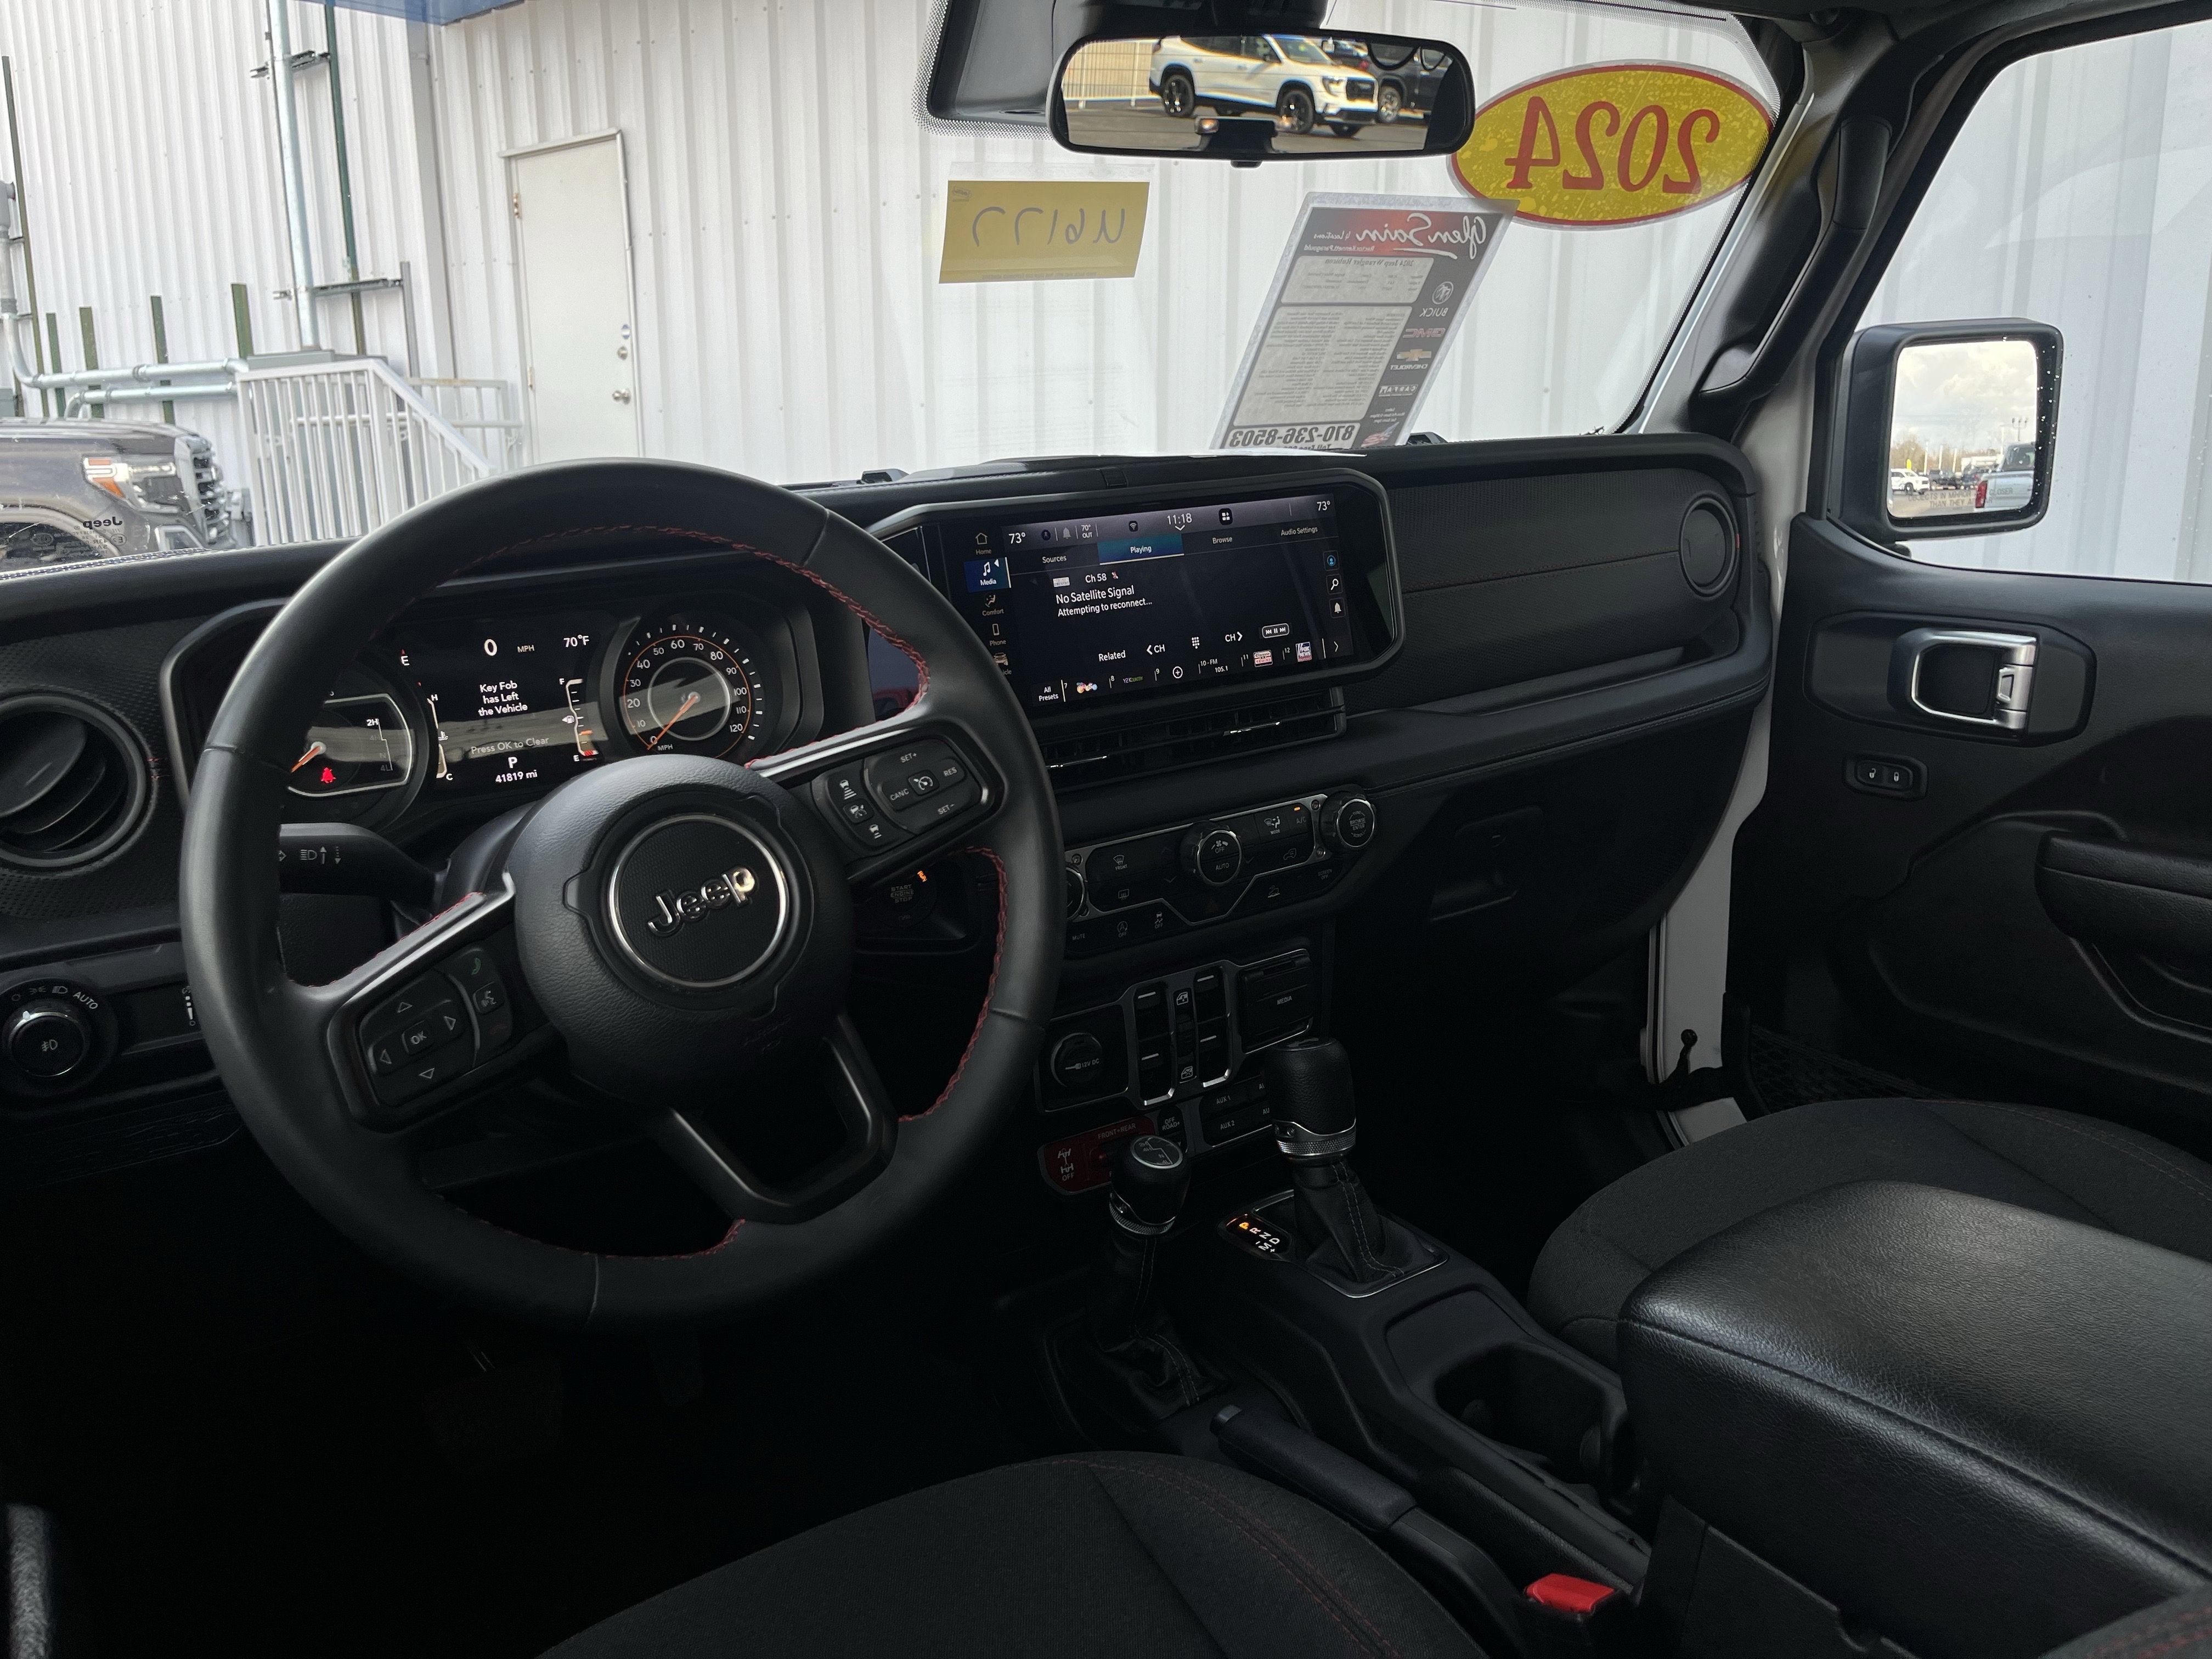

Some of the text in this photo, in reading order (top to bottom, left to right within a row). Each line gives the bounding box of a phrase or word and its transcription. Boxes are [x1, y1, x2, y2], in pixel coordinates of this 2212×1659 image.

[1008, 532, 1026, 544] 73°
[1167, 513, 1193, 525] 11:18
[1317, 500, 1330, 511] 73°
[1042, 526, 1318, 563] Sources Playing Browse Audio Settings
[1085, 573, 1107, 583] Ch 58
[1056, 585, 1135, 604] No Satellite Signal
[1058, 605, 1100, 617] Attempting
[1110, 598, 1153, 610] reconnect...
[1225, 634, 1236, 642] CH
[484, 634, 590, 656] 0 MPH 70°F
[670, 639, 685, 649] 60
[693, 643, 704, 651] 70
[1154, 644, 1165, 653] CH
[653, 647, 664, 656] 50
[710, 651, 724, 661] 80
[1098, 650, 1126, 662] Related
[400, 656, 410, 666] E
[636, 659, 651, 669] 40
[479, 681, 518, 693] Key Fob
[630, 679, 641, 687] 30
[733, 687, 747, 696] 100
[482, 692, 519, 704] has Left
[1039, 693, 1059, 702] Presets
[627, 698, 641, 708] 20
[478, 703, 528, 716] the Vehicle
[736, 706, 747, 714] 110
[366, 718, 379, 726] 2H
[730, 724, 743, 732] 120
[650, 736, 658, 744] 0
[471, 737, 549, 754] Press OK to Clear
[508, 757, 518, 769] P
[495, 770, 538, 783] 41819 mi
[943, 767, 957, 777] RES
[890, 788, 910, 801] CANC
[1296, 816, 1307, 824] A/C
[1350, 817, 1366, 825] BROWSE
[1215, 862, 1229, 871] AUTO
[1318, 868, 1333, 877] SCREEN
[890, 889, 915, 898] ENGINE
[647, 867, 756, 935] Jeep
[73, 991, 98, 1009] AUTO
[1277, 995, 1293, 1005] MEDIA
[410, 1030, 427, 1044] OK
[1081, 1060, 1091, 1069] 12V
[1164, 1116, 1175, 1125] OFF
[1220, 1122, 1231, 1130] AUX
[1062, 1171, 1075, 1181] OFF
